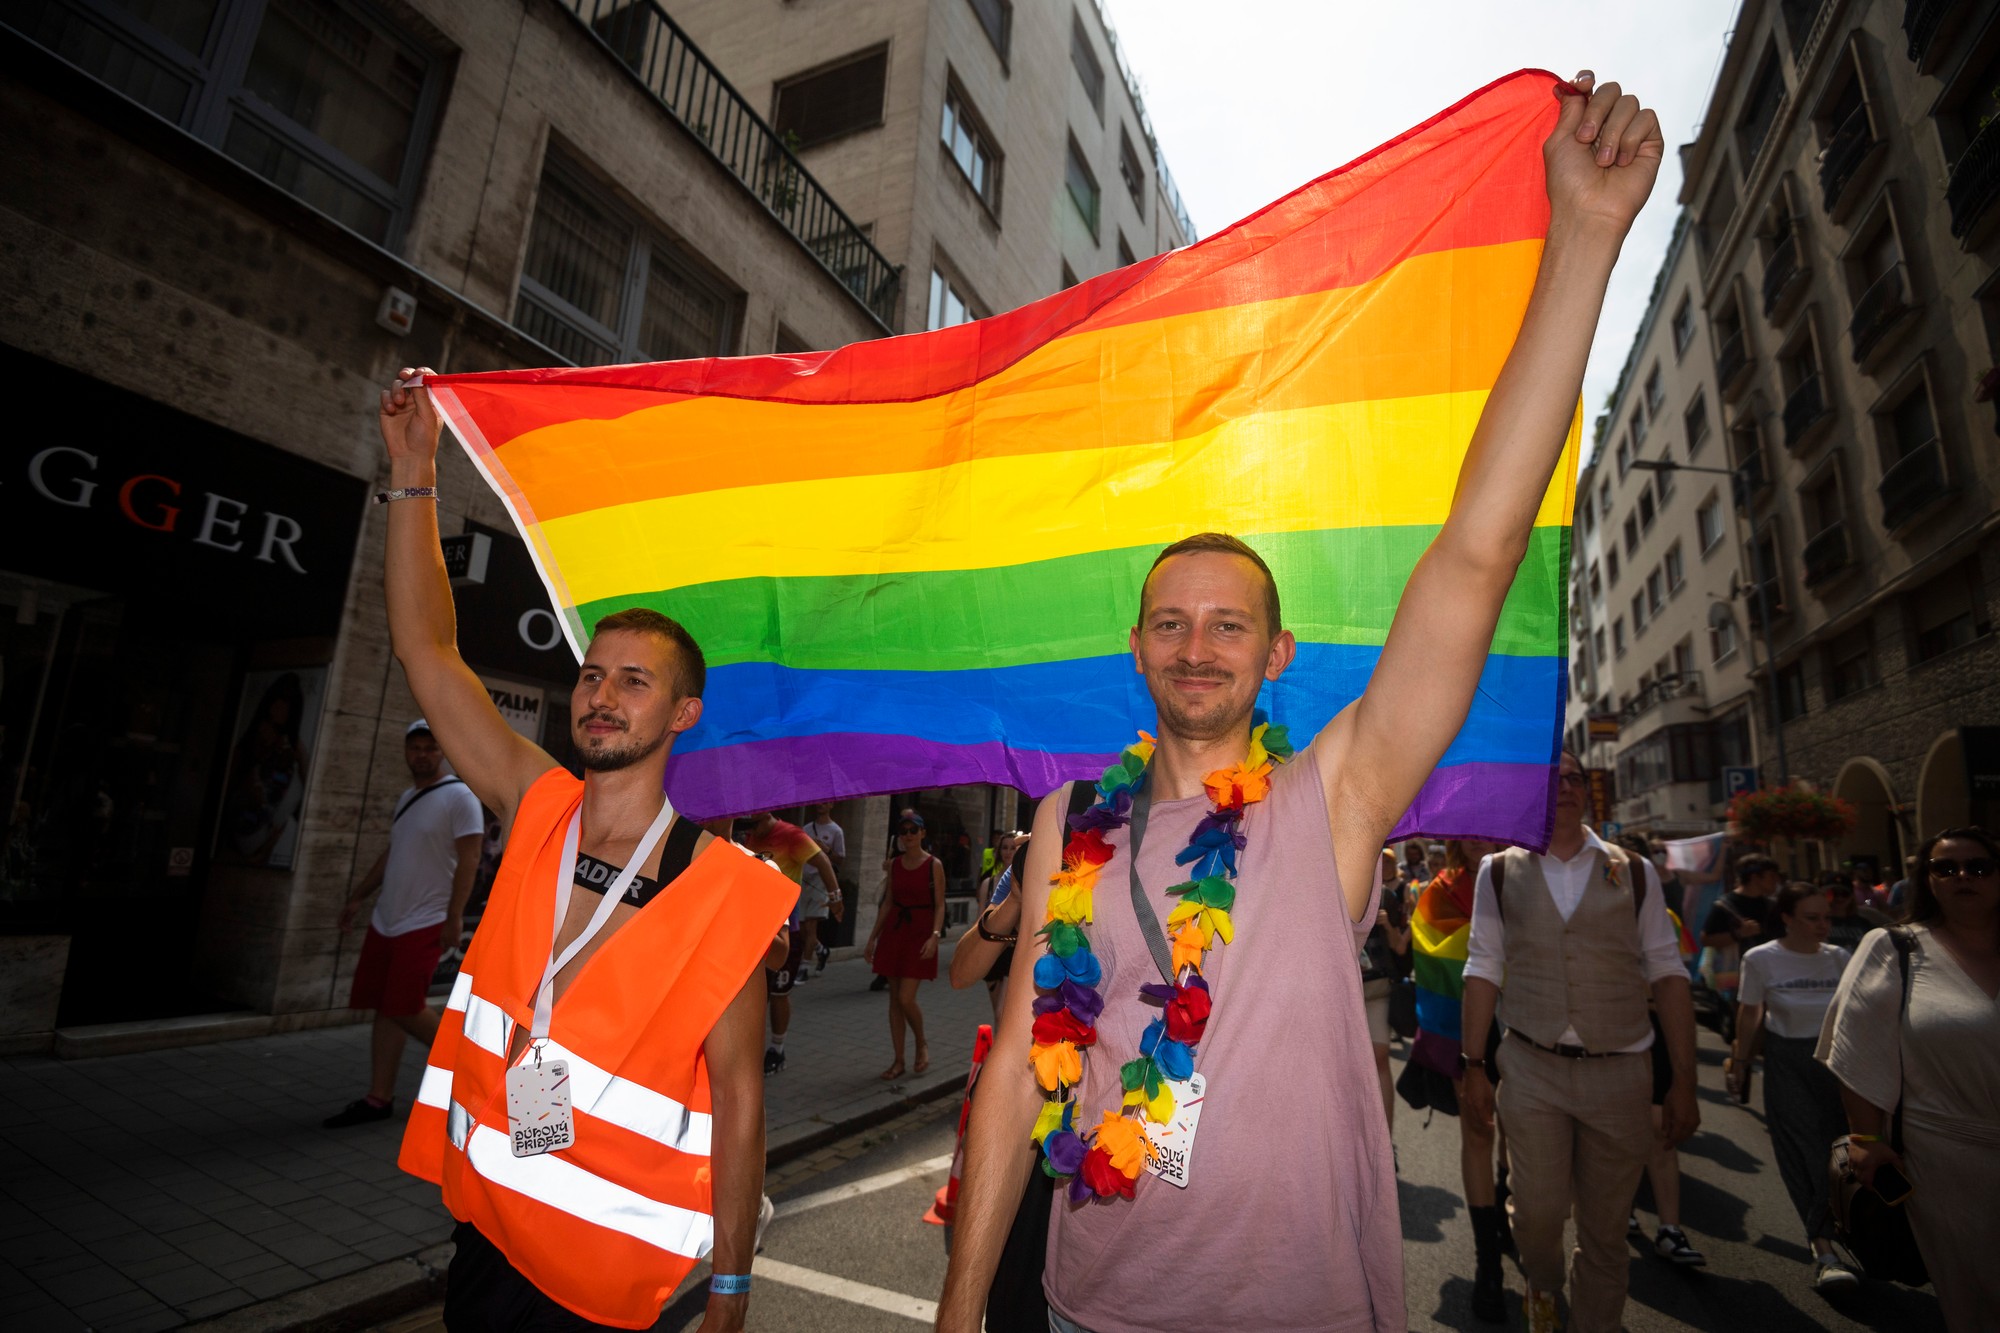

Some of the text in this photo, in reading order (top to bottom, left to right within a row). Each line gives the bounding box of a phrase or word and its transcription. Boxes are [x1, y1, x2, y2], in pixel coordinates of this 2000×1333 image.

[0, 445, 309, 576] GGER
[1728, 771, 1747, 797] P
[1144, 1153, 1184, 1180] RIDE22
